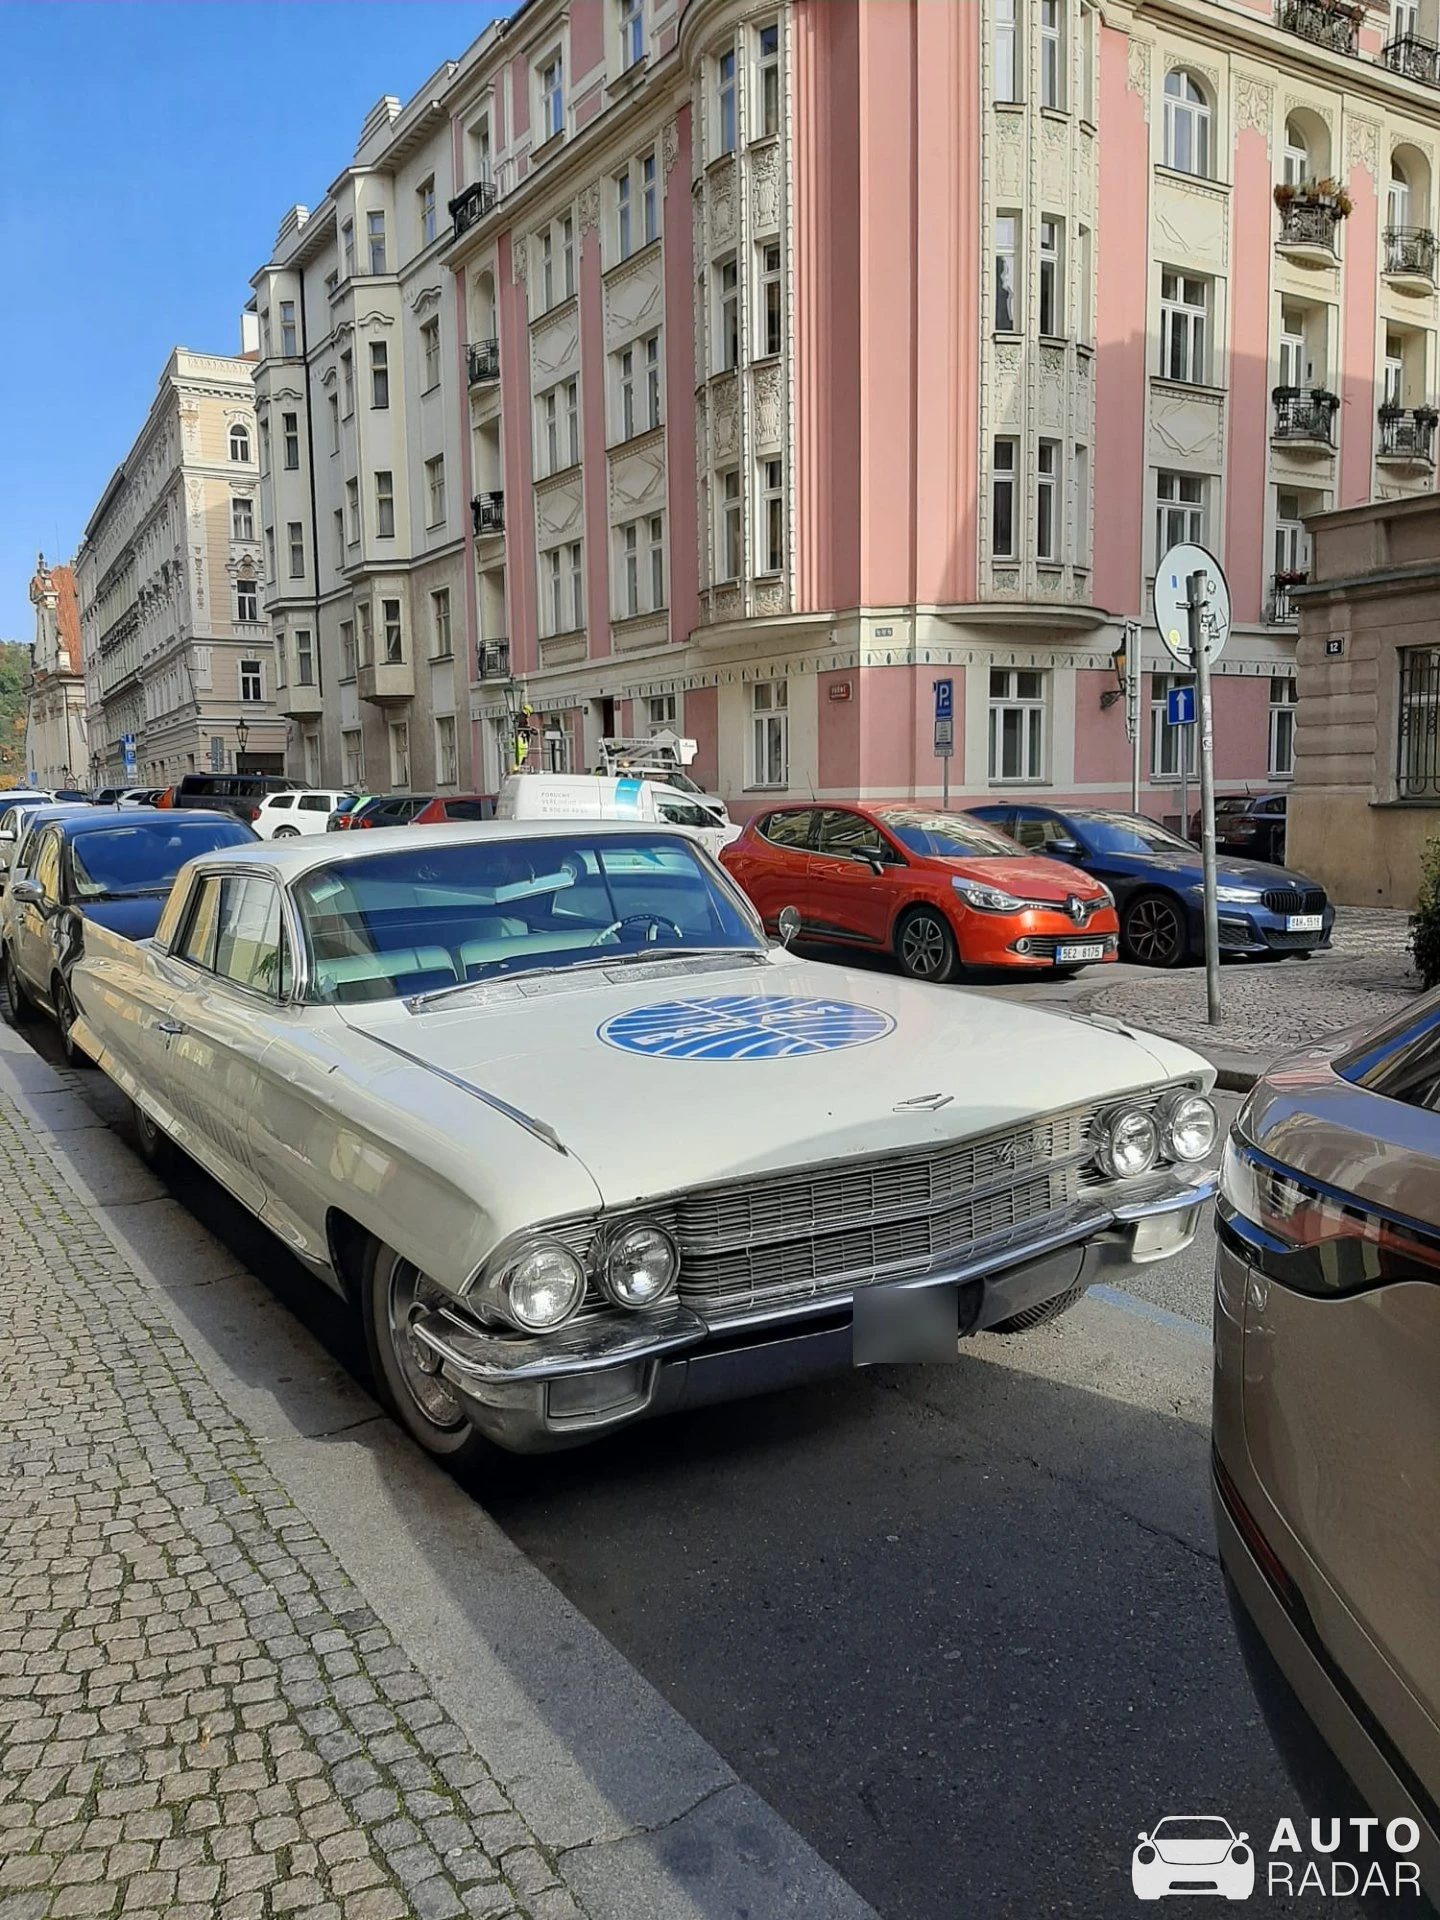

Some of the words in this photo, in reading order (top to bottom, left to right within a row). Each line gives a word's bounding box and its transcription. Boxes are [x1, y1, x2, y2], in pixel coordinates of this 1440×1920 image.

[1330, 642, 1339, 652] 12
[938, 683, 950, 707] P
[1063, 947, 1078, 959] 5E2
[630, 1018, 750, 1047] PAN
[760, 1004, 846, 1025] AM
